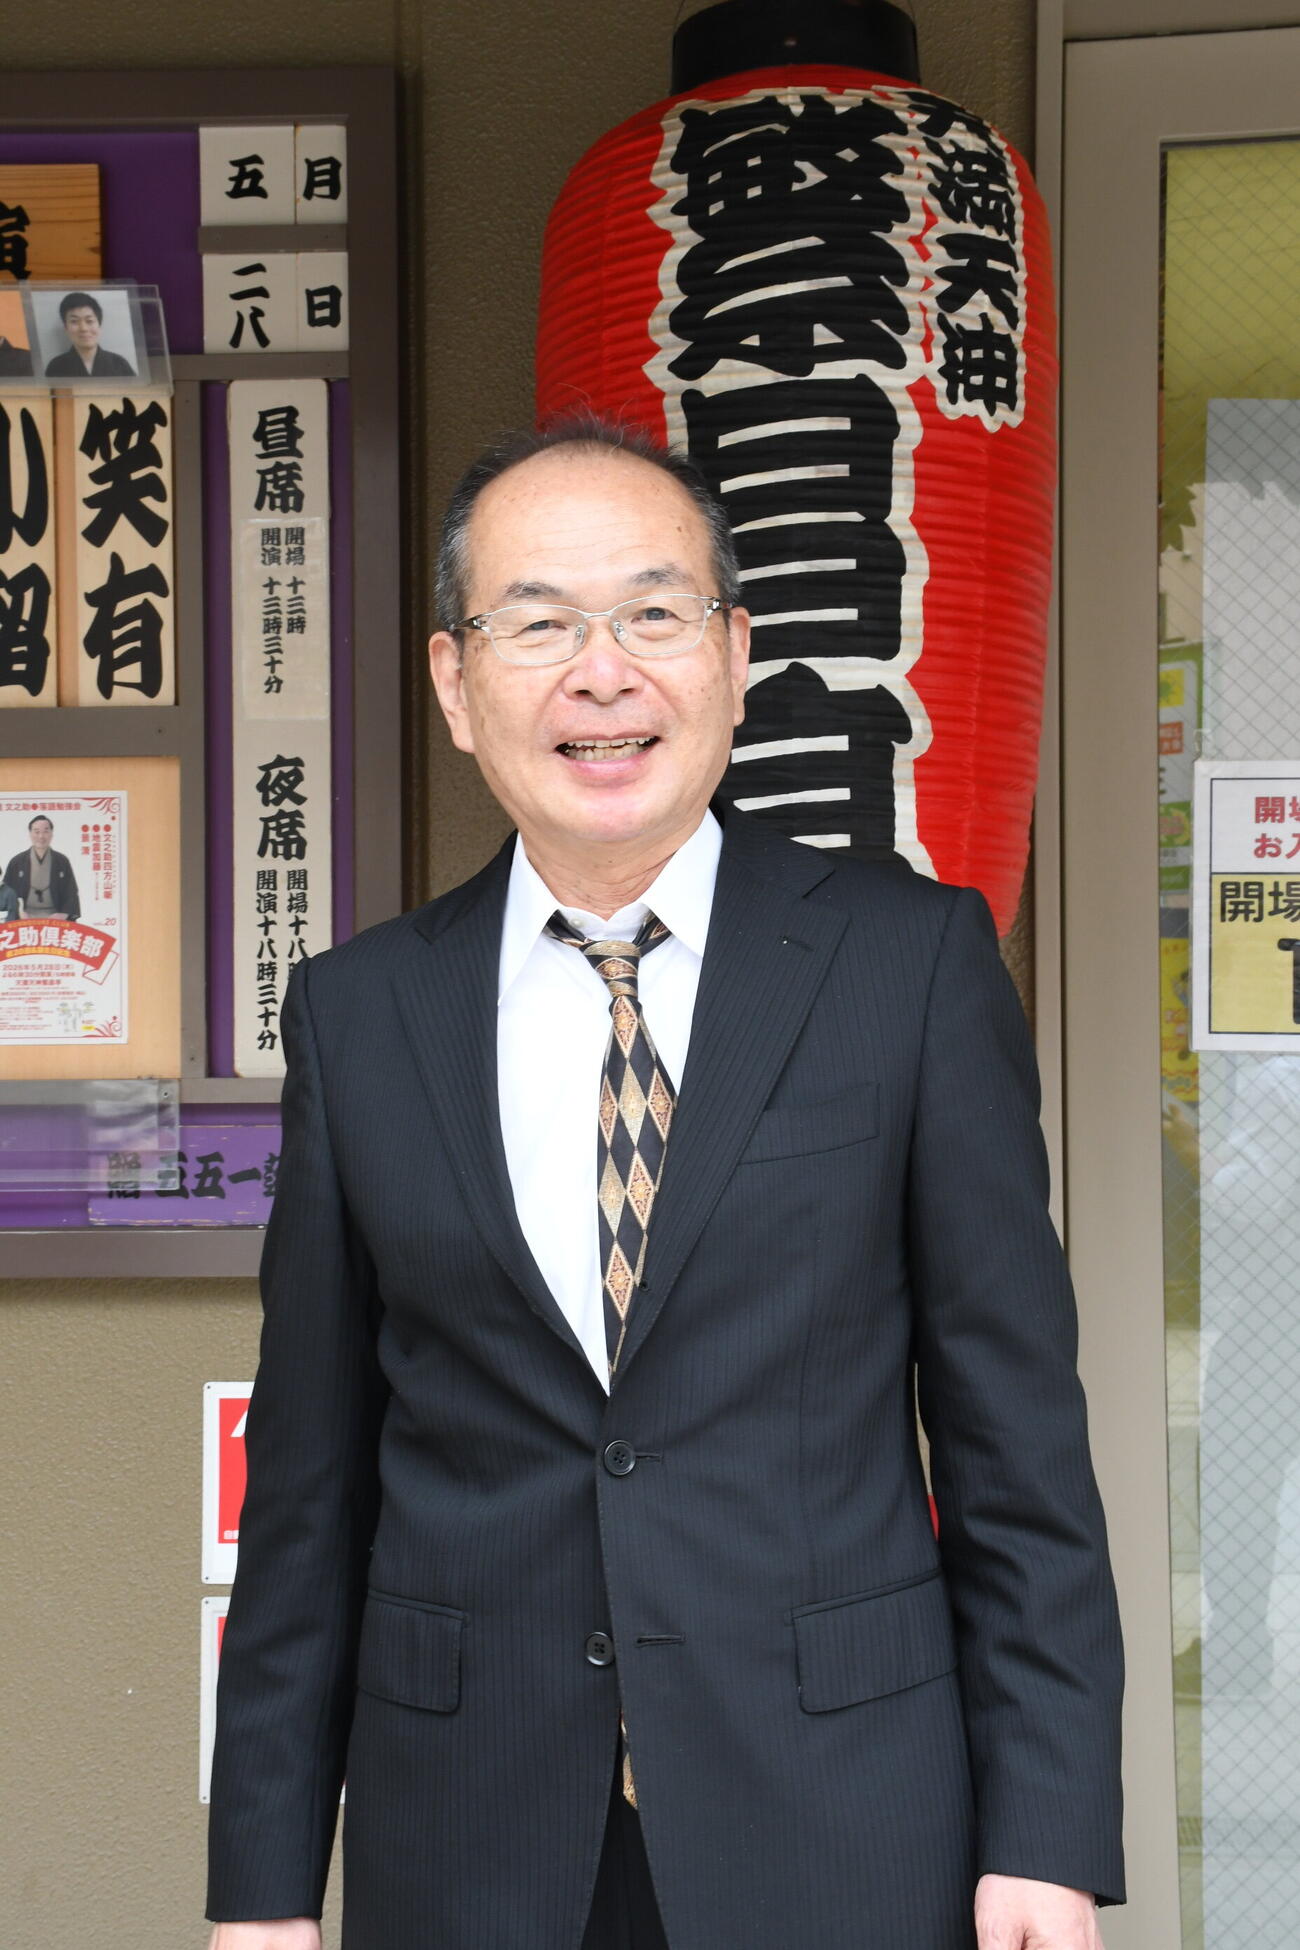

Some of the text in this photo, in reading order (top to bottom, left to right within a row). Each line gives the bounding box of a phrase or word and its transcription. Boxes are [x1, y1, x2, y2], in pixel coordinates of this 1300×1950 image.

[252, 405, 305, 514] 昼席
[79, 397, 170, 700] 笑有
[261, 527, 281, 567] 開演
[285, 526, 306, 567] 開場
[256, 754, 308, 861] 夜席
[256, 869, 279, 1051] 開演十八時三十分
[287, 868, 309, 982] 開場十八
